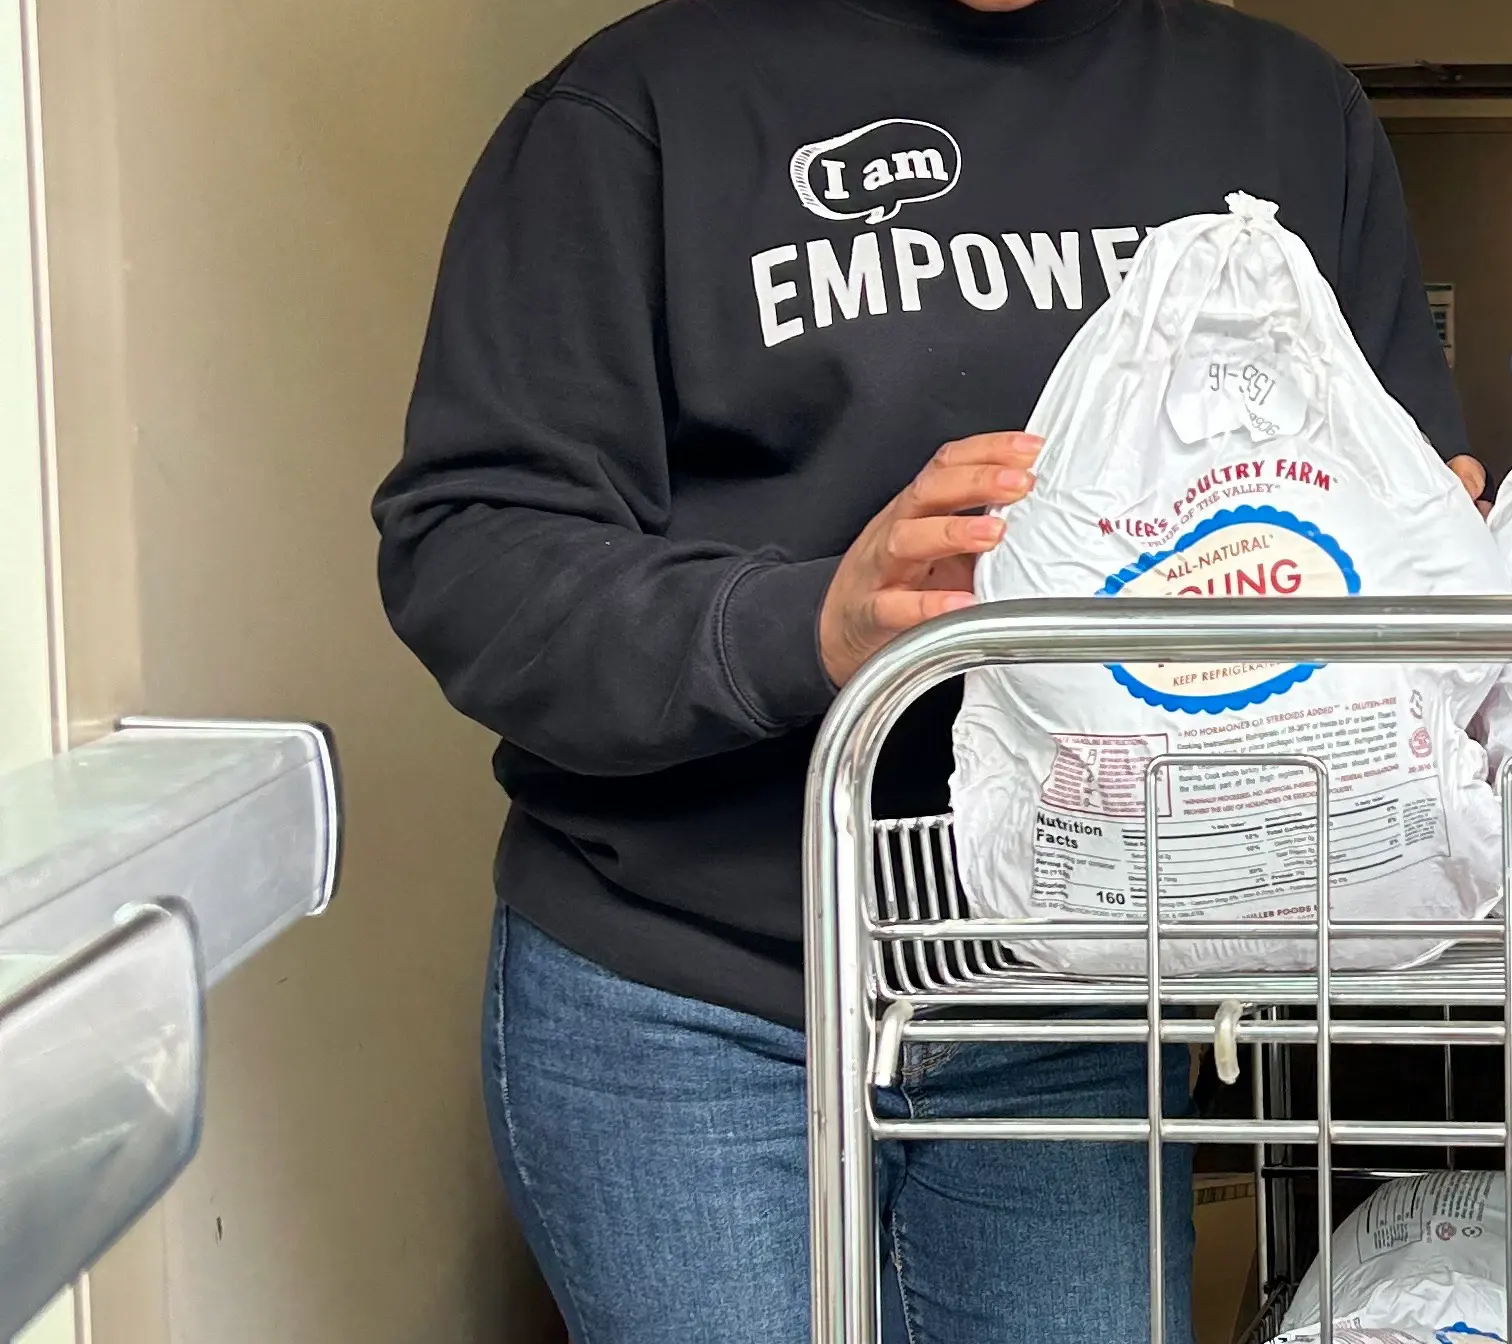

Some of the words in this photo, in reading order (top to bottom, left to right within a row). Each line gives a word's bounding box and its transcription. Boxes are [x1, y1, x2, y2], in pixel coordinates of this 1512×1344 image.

[821, 159, 849, 200] I
[863, 146, 949, 191] am
[751, 225, 1156, 347] EMPOWE
[1173, 460, 1266, 516] POULTRY
[1180, 507, 1195, 525] OF
[1196, 491, 1220, 512] THE
[1167, 559, 1302, 597] UNG
[1173, 674, 1198, 687] KEEP
[1202, 663, 1280, 682] REFRIGERA
[1184, 729, 1197, 737] NO
[1252, 718, 1263, 727] OR
[1266, 710, 1304, 724] STEROIDS
[1036, 811, 1103, 837] Nutrition
[1036, 828, 1079, 849] Facts
[1096, 891, 1126, 905] 160
